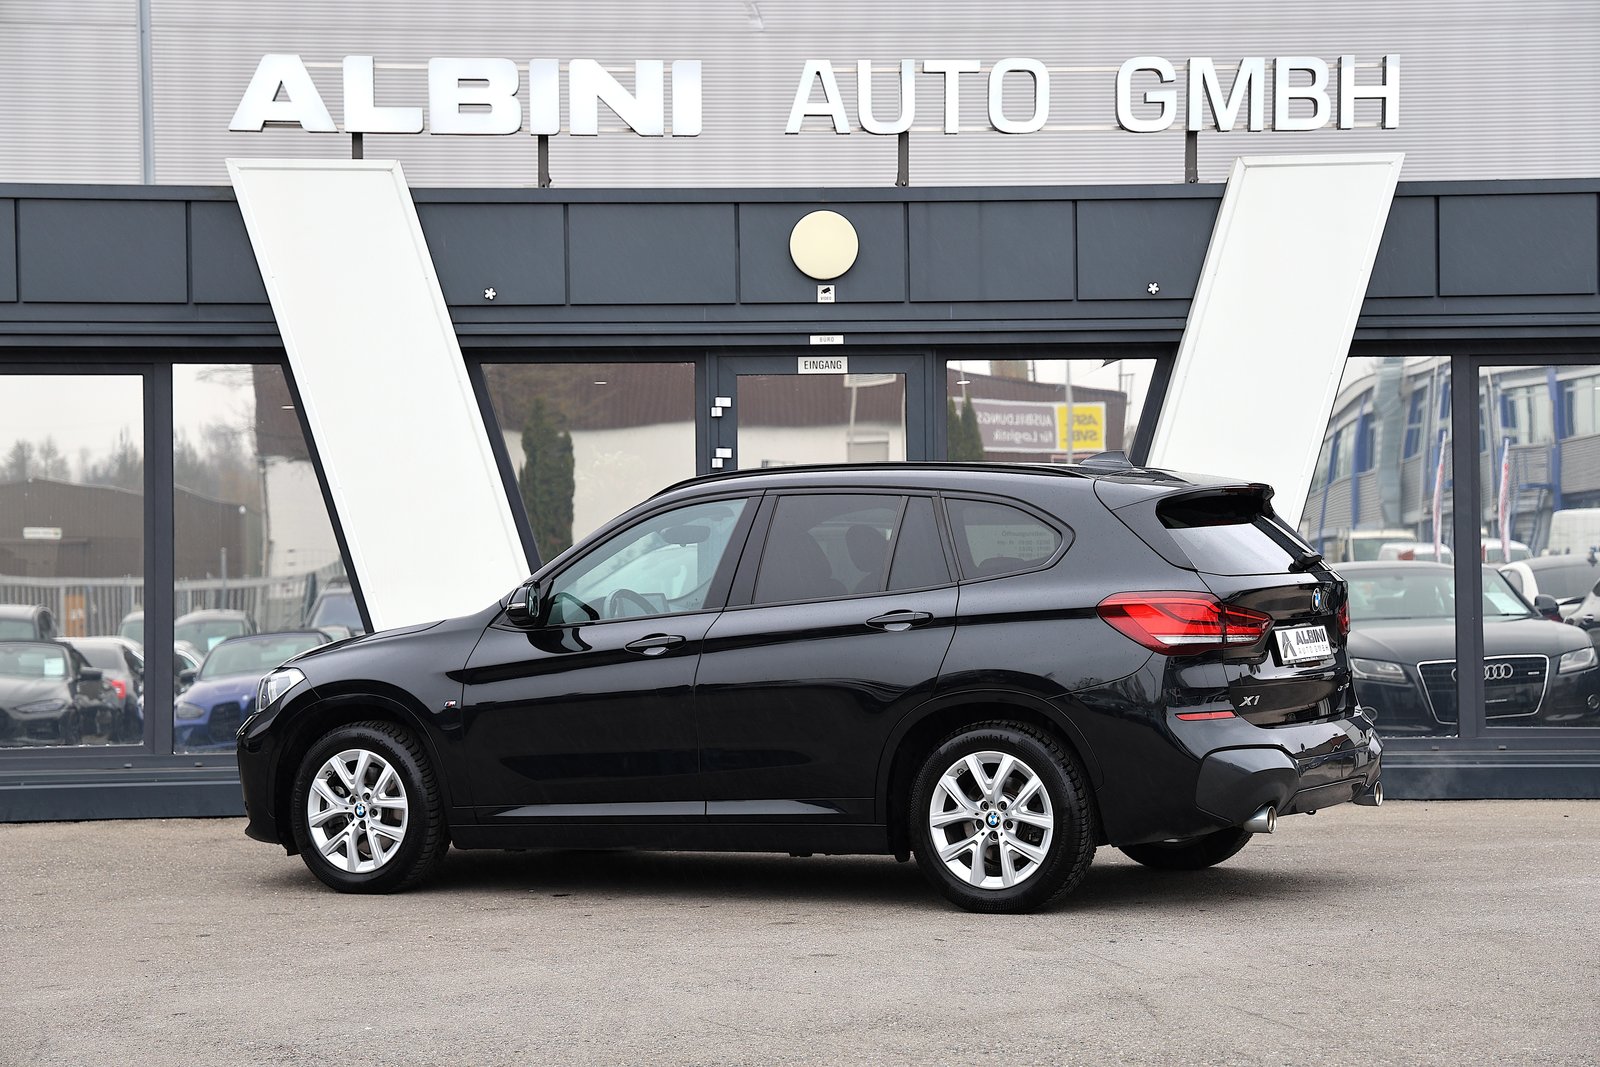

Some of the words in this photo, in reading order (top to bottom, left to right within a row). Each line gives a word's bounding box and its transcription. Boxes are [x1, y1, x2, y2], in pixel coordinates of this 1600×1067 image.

[228, 54, 702, 138] ALBINI
[784, 57, 1051, 135] AUTO
[1116, 54, 1401, 132] GMBH
[804, 360, 842, 370] EINGANG
[1295, 628, 1326, 645] ALBINI
[1239, 695, 1260, 707] X1
